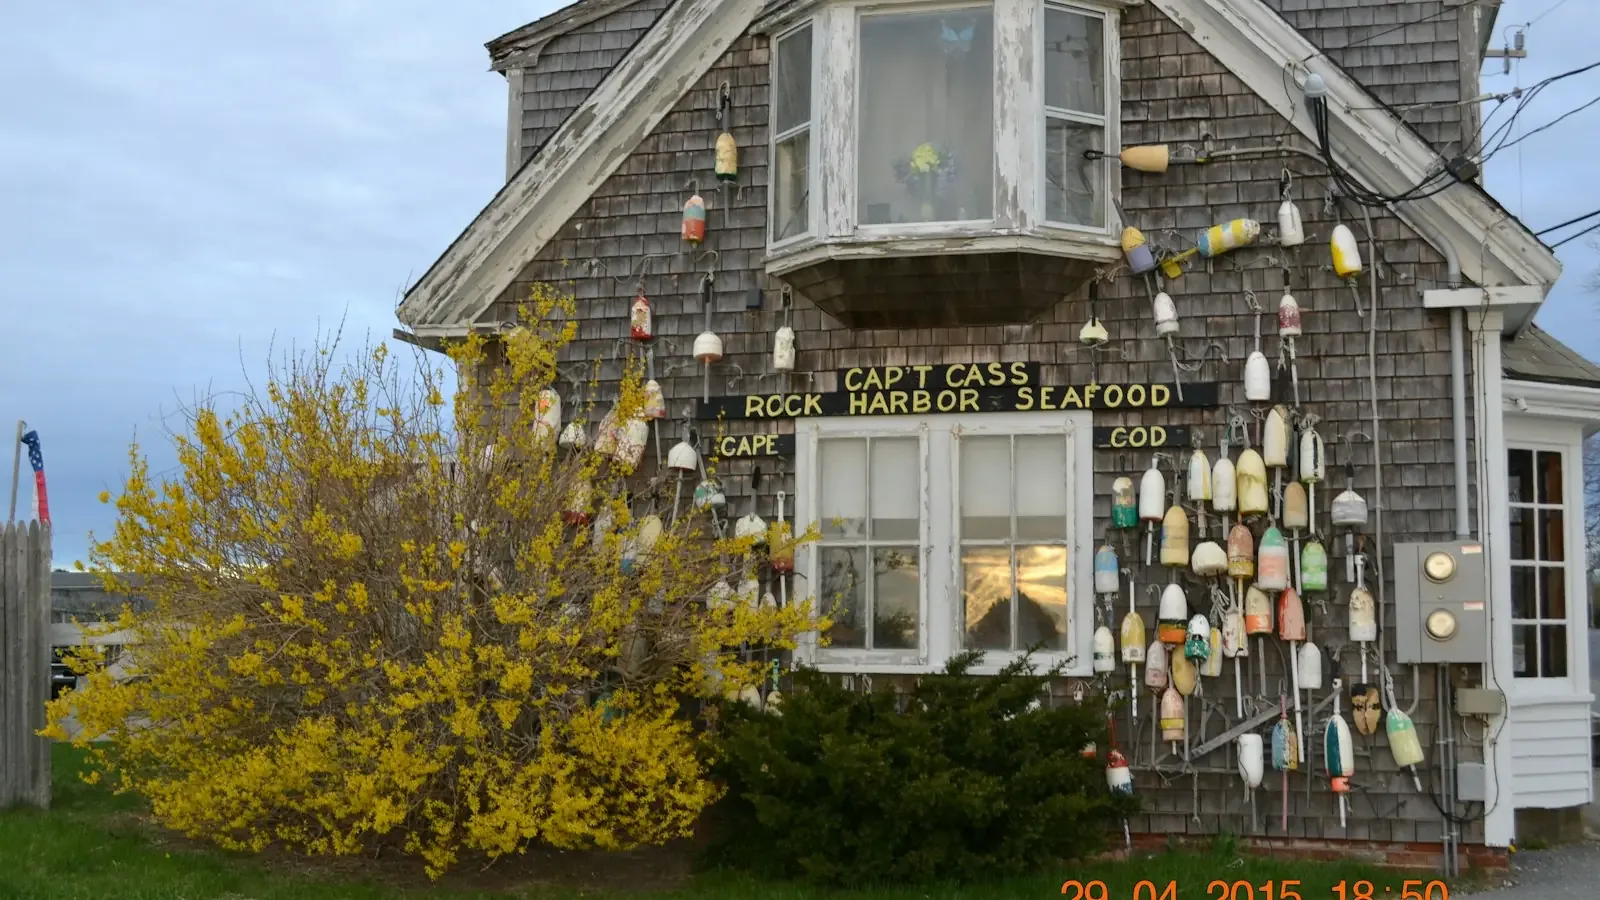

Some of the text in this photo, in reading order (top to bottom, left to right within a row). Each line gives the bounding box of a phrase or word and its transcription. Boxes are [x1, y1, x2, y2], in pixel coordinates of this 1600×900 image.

[845, 361, 1030, 392] CAP'T CASS
[745, 383, 1172, 418] ROCK HARBOR SEAFOOD
[720, 433, 779, 457] CAPE
[1110, 426, 1167, 448] COD
